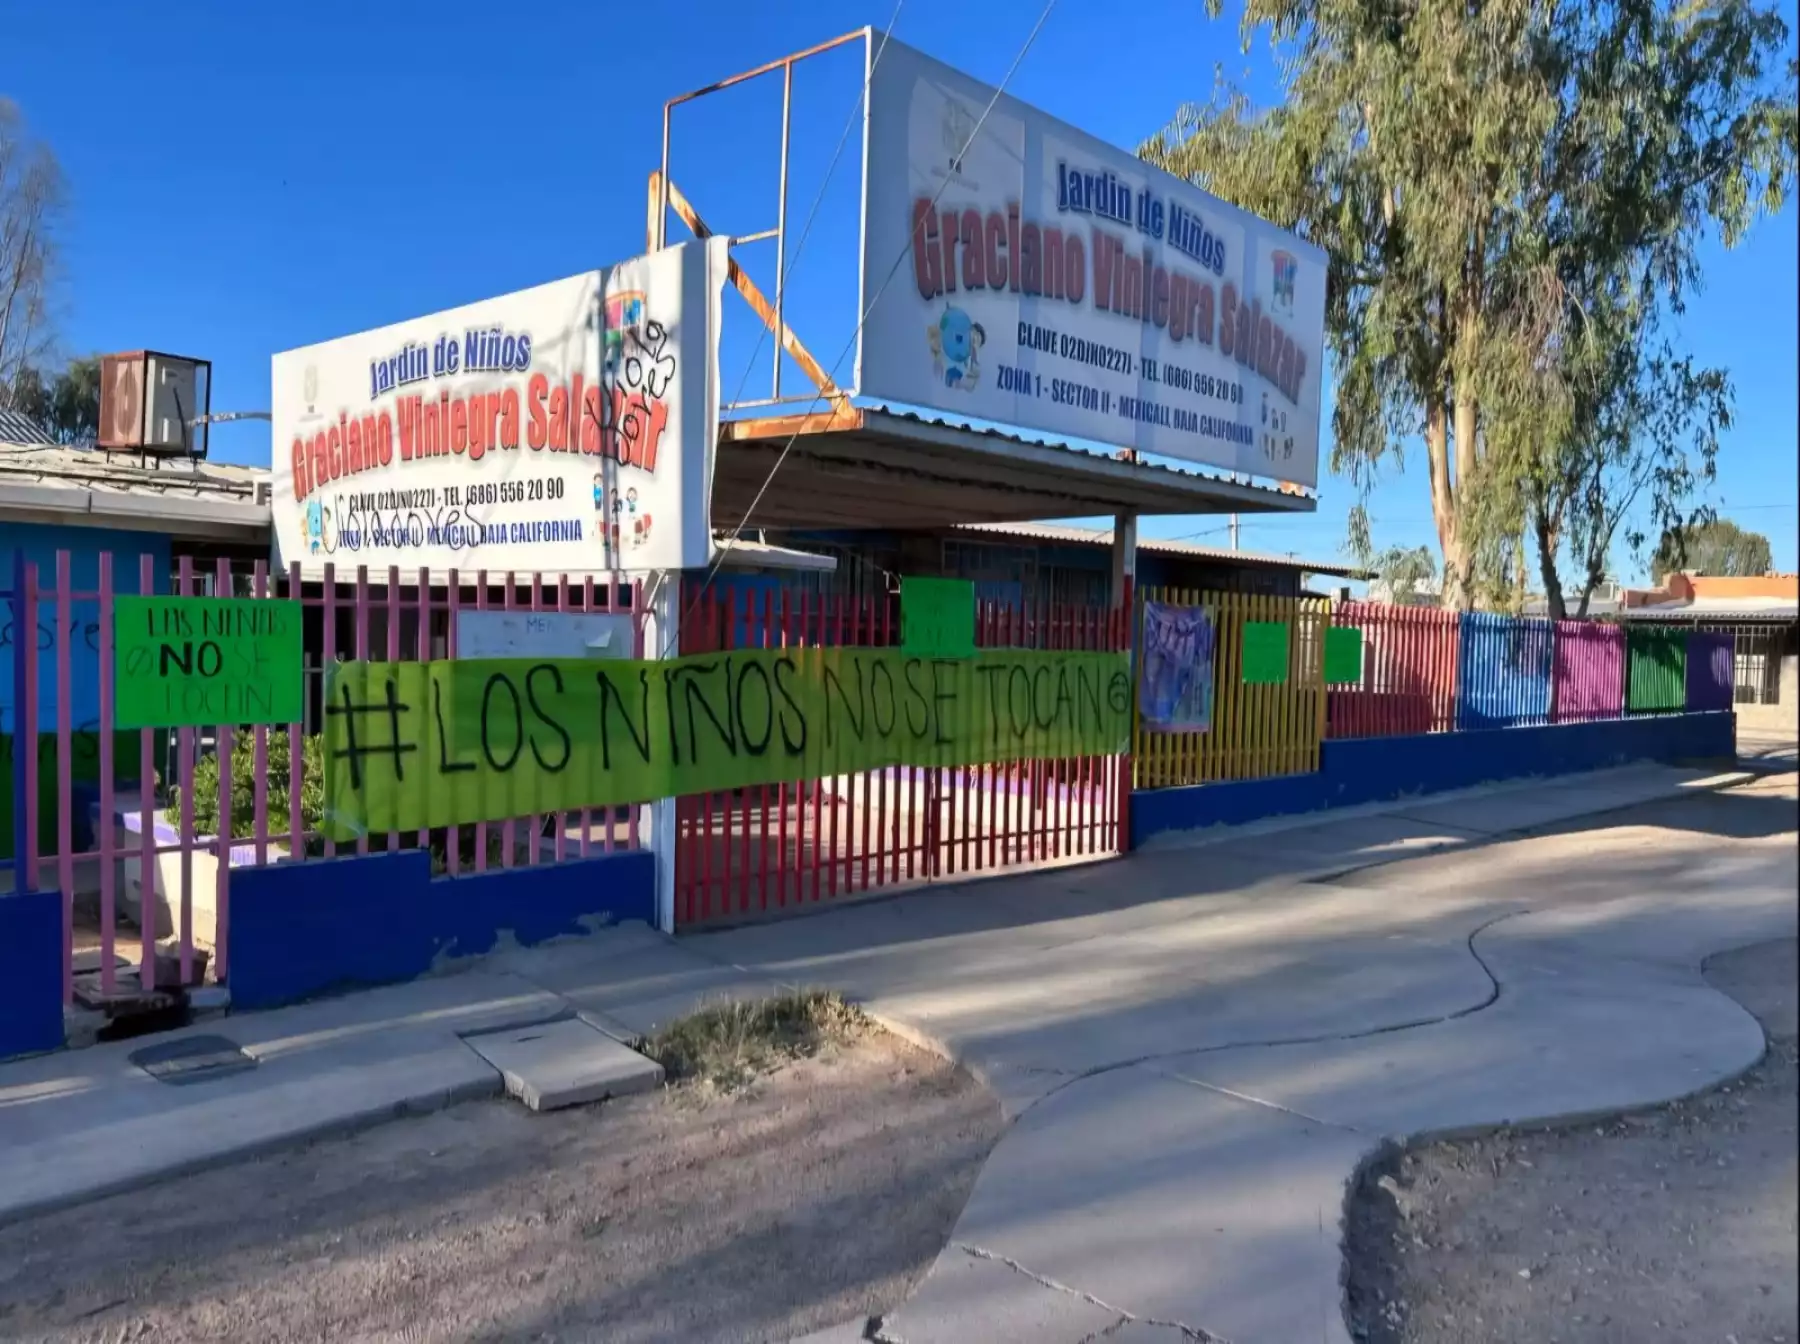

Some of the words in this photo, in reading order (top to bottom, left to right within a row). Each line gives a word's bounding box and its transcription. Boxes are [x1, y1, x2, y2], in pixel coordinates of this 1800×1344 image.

[1057, 163, 1133, 227] Jardin
[1136, 189, 1164, 240] de
[1168, 201, 1225, 277] Niños
[912, 196, 1085, 304] Graciano
[1092, 229, 1214, 343] Viniegra
[1219, 282, 1307, 406] Salazar
[370, 343, 430, 400] Jardin
[433, 335, 460, 377] de
[463, 328, 532, 373] Niños
[997, 364, 1032, 396] ZONA
[1035, 374, 1041, 398] 1
[1052, 378, 1099, 411] SECTOR
[1101, 391, 1110, 414] II
[1173, 408, 1198, 434] BAJA
[1018, 321, 1058, 355] CLAVE
[1216, 378, 1229, 401] 20
[291, 408, 394, 502] Graciano
[397, 386, 519, 461] Viniegra
[527, 373, 669, 474] Salazar
[443, 486, 463, 507] TEL.
[466, 483, 498, 506] (686)
[500, 480, 525, 503] 556
[527, 478, 543, 501] 20
[547, 476, 565, 499] 90
[510, 518, 583, 544] CALIFORNIA
[159, 640, 223, 678] NO
[596, 655, 807, 771] NIÑOS
[823, 656, 896, 748] NO
[904, 657, 959, 747] SE
